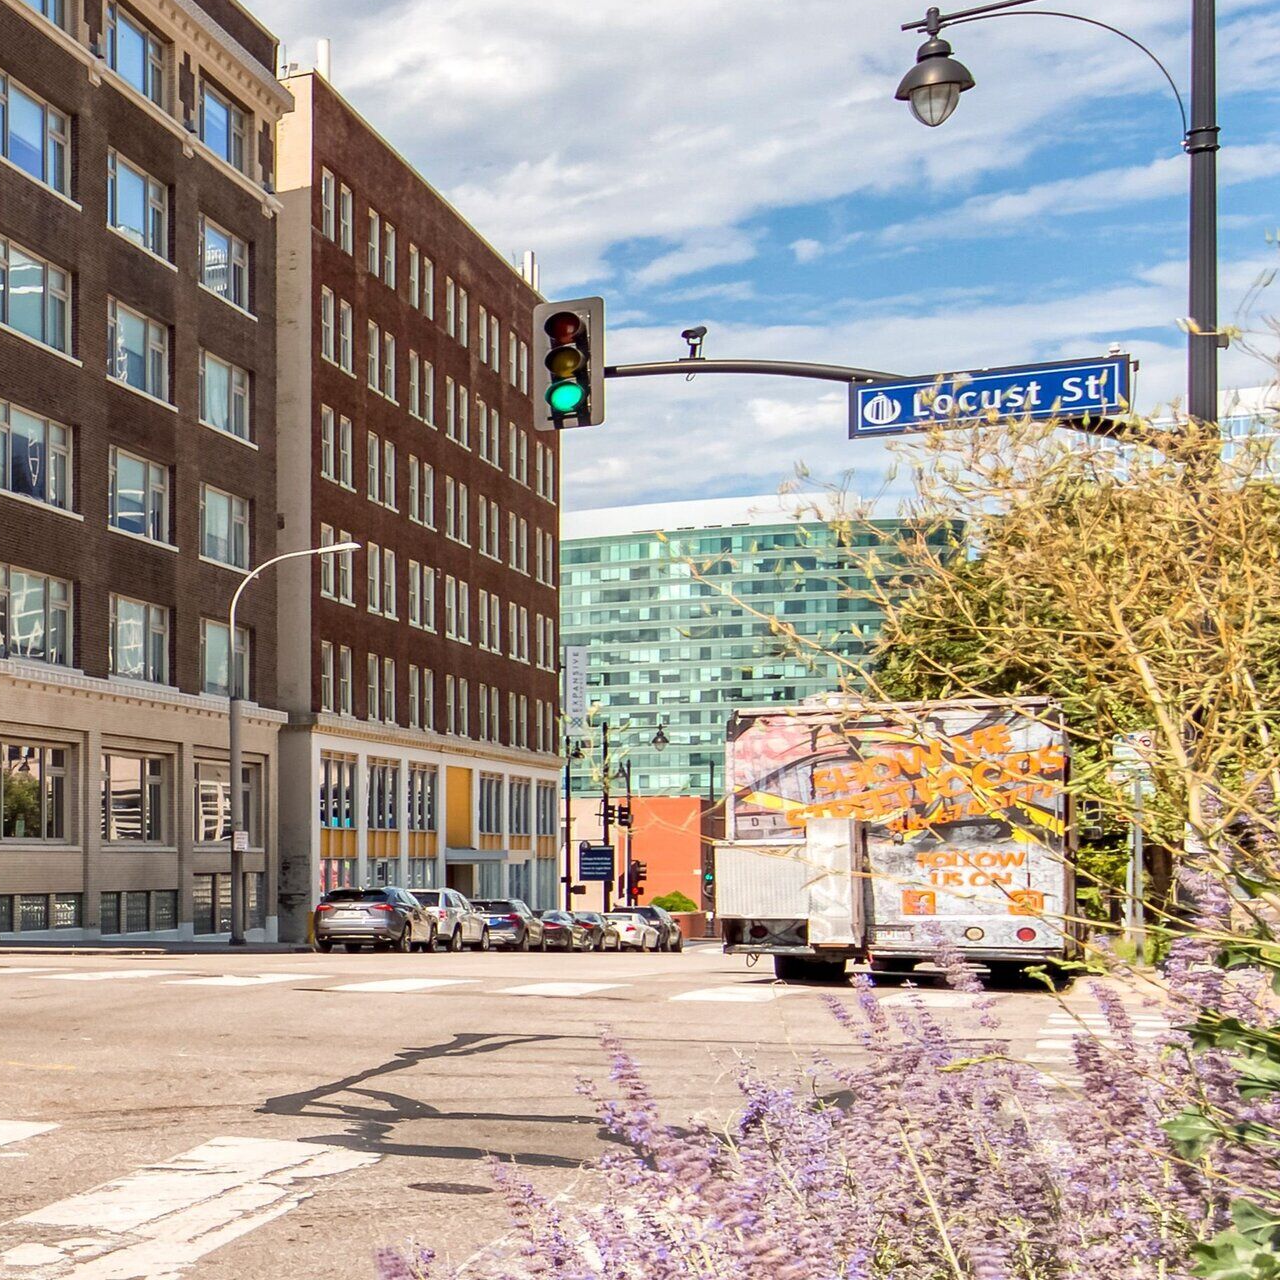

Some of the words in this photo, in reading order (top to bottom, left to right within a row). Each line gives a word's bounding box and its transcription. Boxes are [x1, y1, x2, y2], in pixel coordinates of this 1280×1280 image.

[913, 380, 1041, 417] Locust
[1062, 375, 1100, 402] St
[916, 851, 1027, 868] FOLLOW
[930, 872, 965, 886] US
[969, 872, 1013, 886] ON
